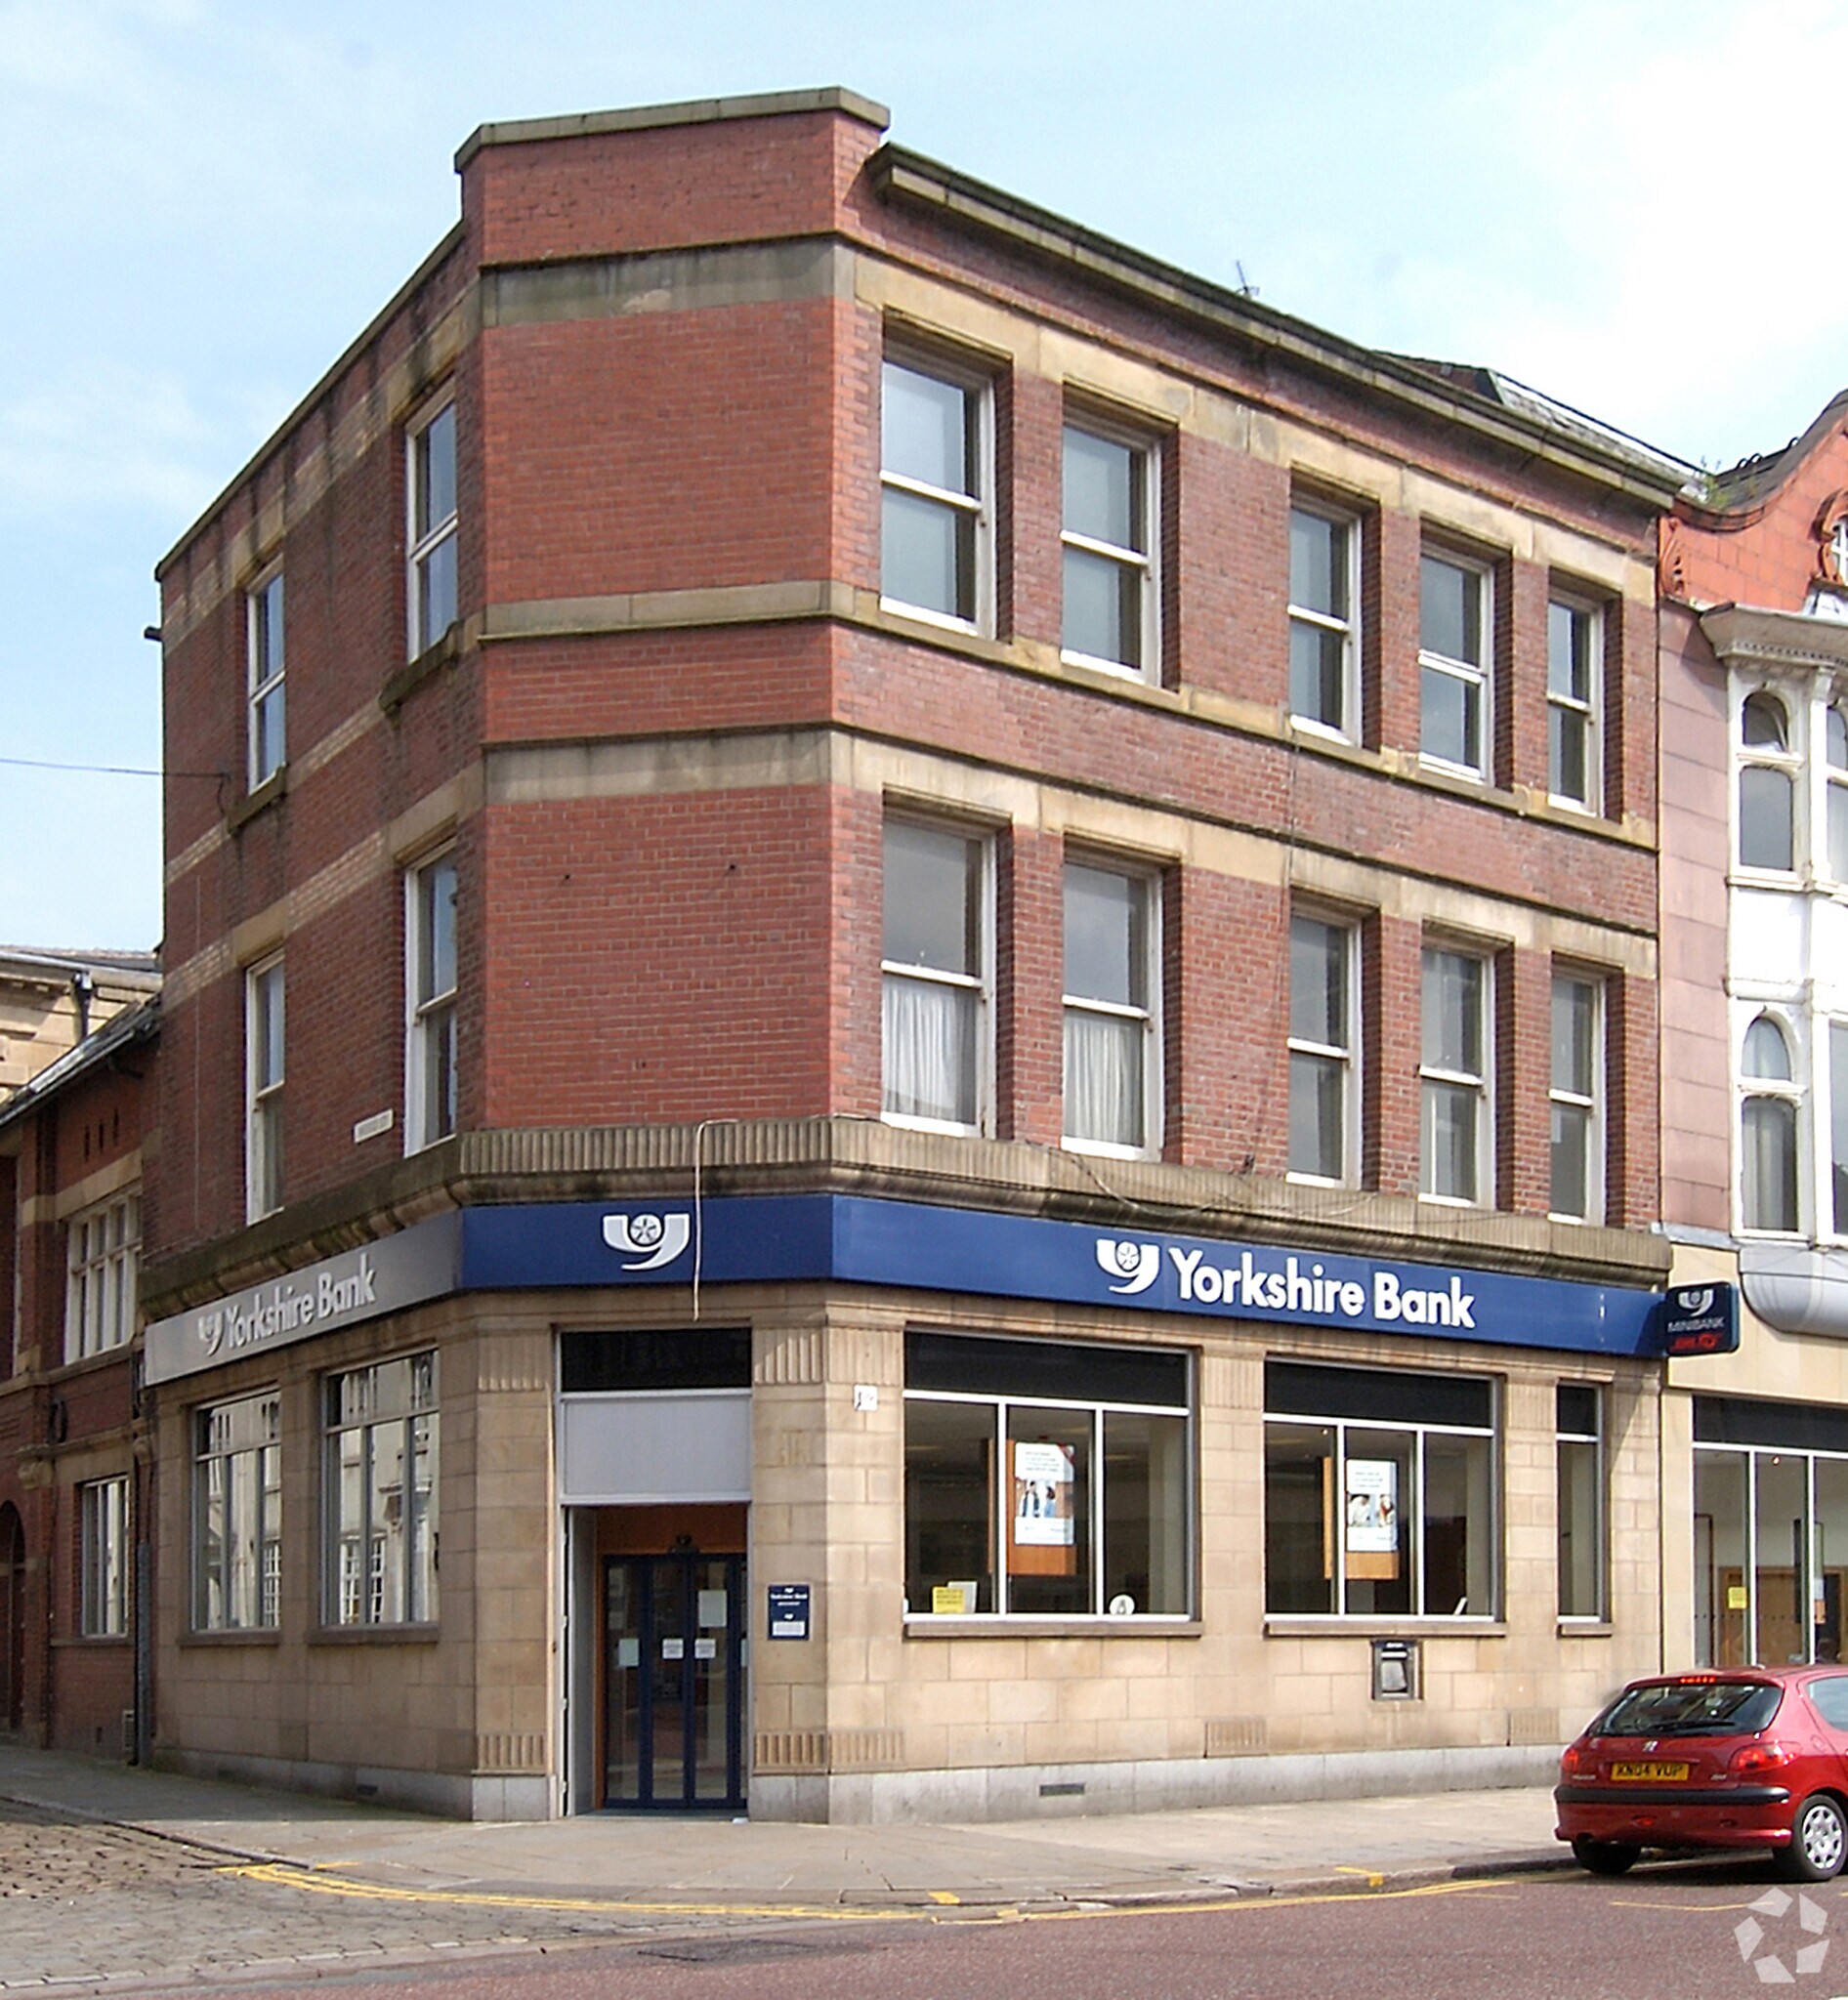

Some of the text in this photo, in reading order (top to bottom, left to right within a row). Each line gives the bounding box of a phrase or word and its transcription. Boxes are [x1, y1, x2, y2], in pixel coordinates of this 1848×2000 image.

[225, 1252, 377, 1349] Yorkshire Bank
[1168, 1246, 1477, 1329] Yorkshire Bank
